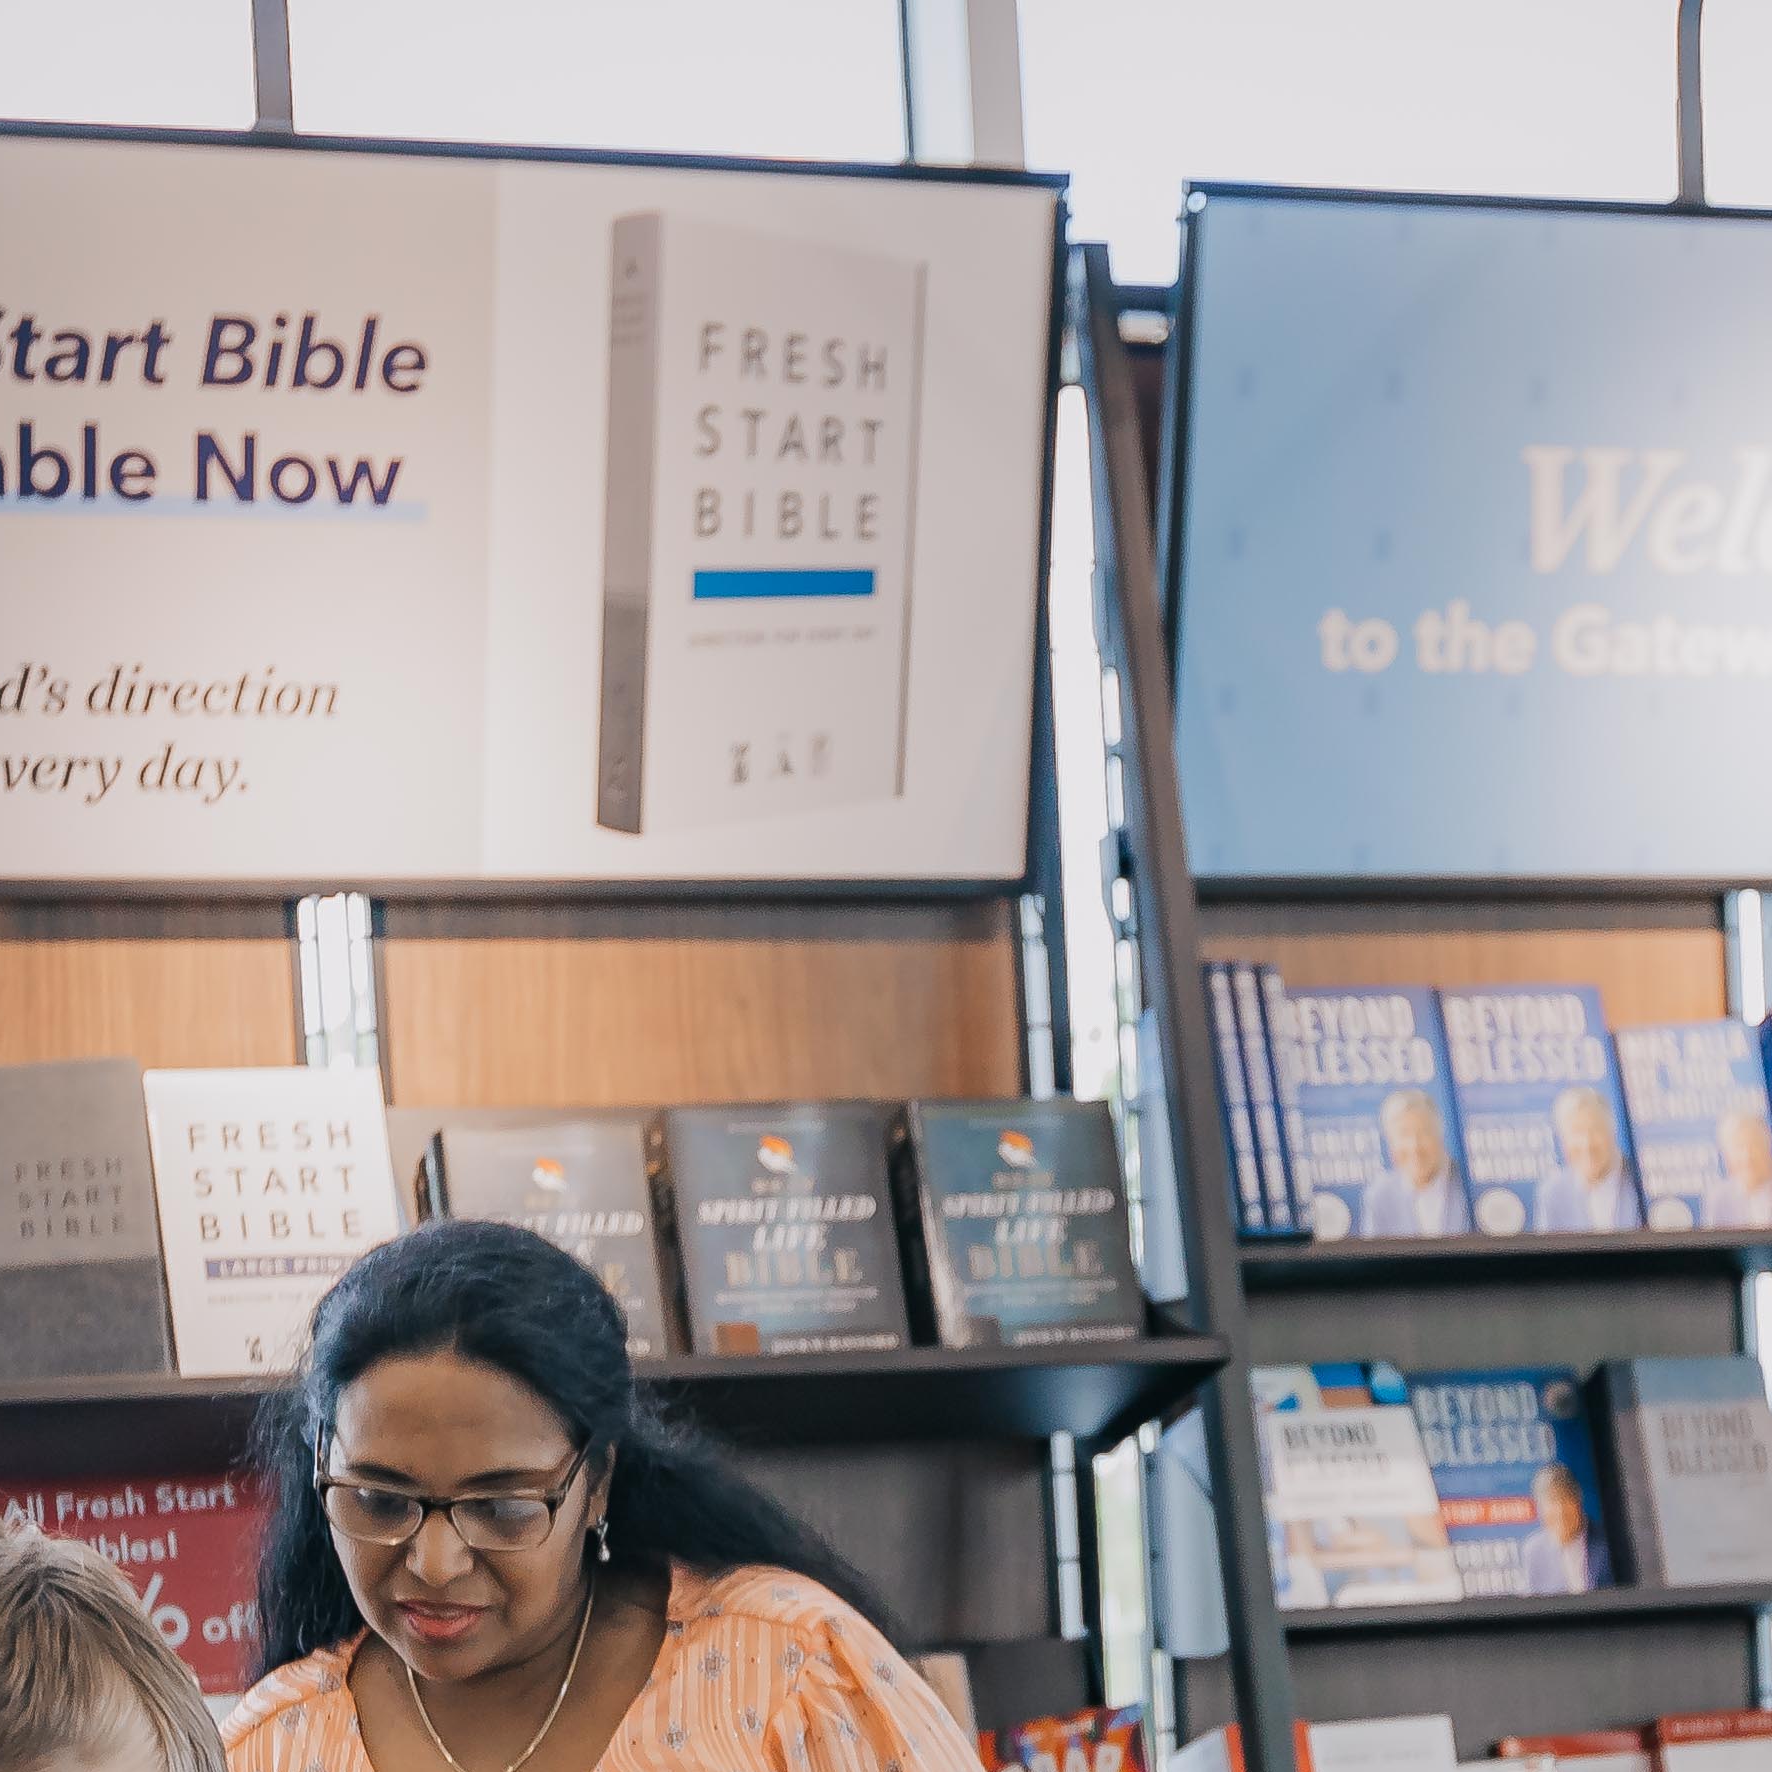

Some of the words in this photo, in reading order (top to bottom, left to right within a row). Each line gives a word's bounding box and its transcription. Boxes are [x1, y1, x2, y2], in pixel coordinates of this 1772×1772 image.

[203, 315, 431, 397] Bible
[699, 320, 888, 391] FRESH
[695, 404, 885, 465] START
[194, 430, 406, 508] Now
[693, 488, 880, 541] BIBLE
[1317, 611, 1397, 673] to
[1415, 600, 1537, 675] the
[84, 662, 341, 721] direction
[136, 744, 250, 806] day.
[188, 1120, 352, 1152] FRESH
[14, 1156, 124, 1184] FRESH
[194, 1164, 354, 1199] START
[18, 1184, 122, 1212] START
[20, 1213, 124, 1240] BIBLE
[200, 1208, 361, 1241] BIBLE
[3, 1490, 45, 1527] All
[56, 1485, 146, 1521] Fresh
[156, 1481, 236, 1512] Start
[90, 1529, 178, 1564] bles!
